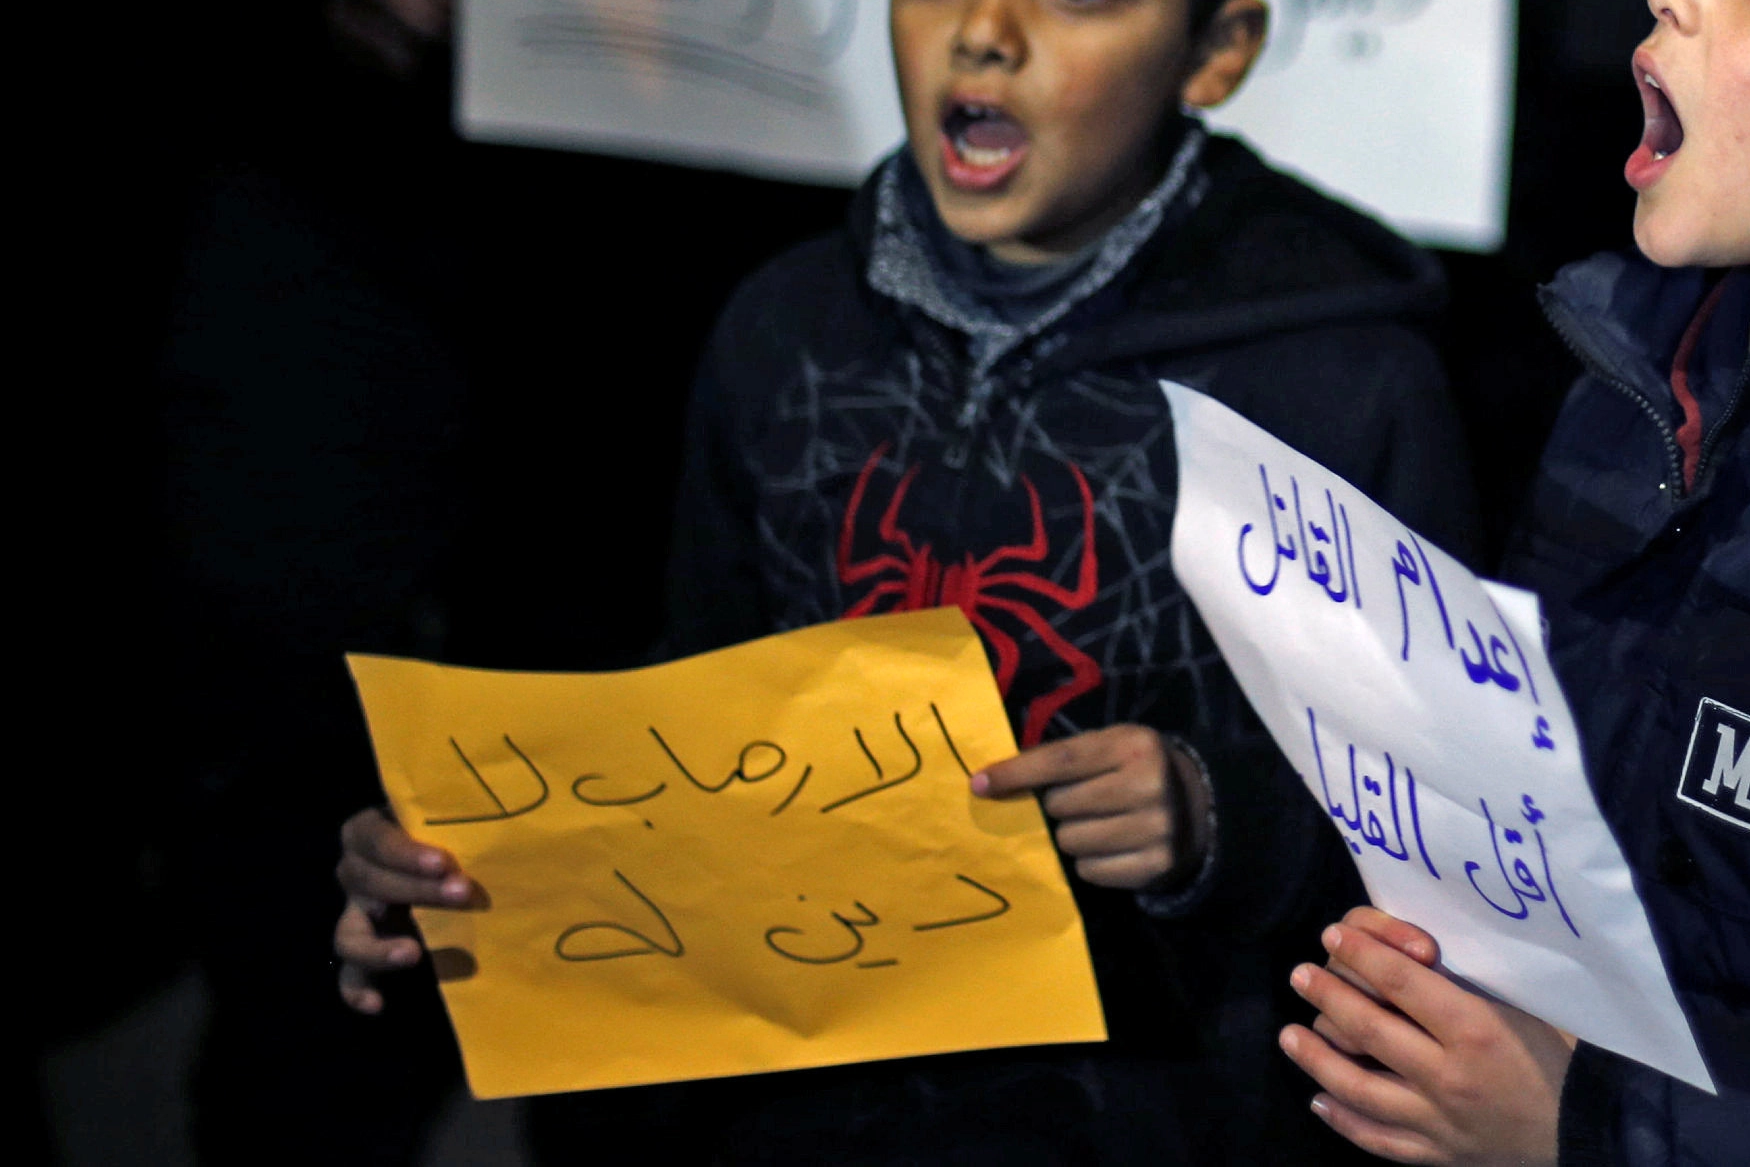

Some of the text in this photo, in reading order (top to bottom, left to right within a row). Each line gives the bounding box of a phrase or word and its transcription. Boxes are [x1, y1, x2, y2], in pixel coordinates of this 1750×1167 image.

[1391, 530, 1556, 752] إعدام
[423, 733, 551, 827] لا
[553, 868, 1011, 970] دين له
[1463, 792, 1581, 939] أقل
